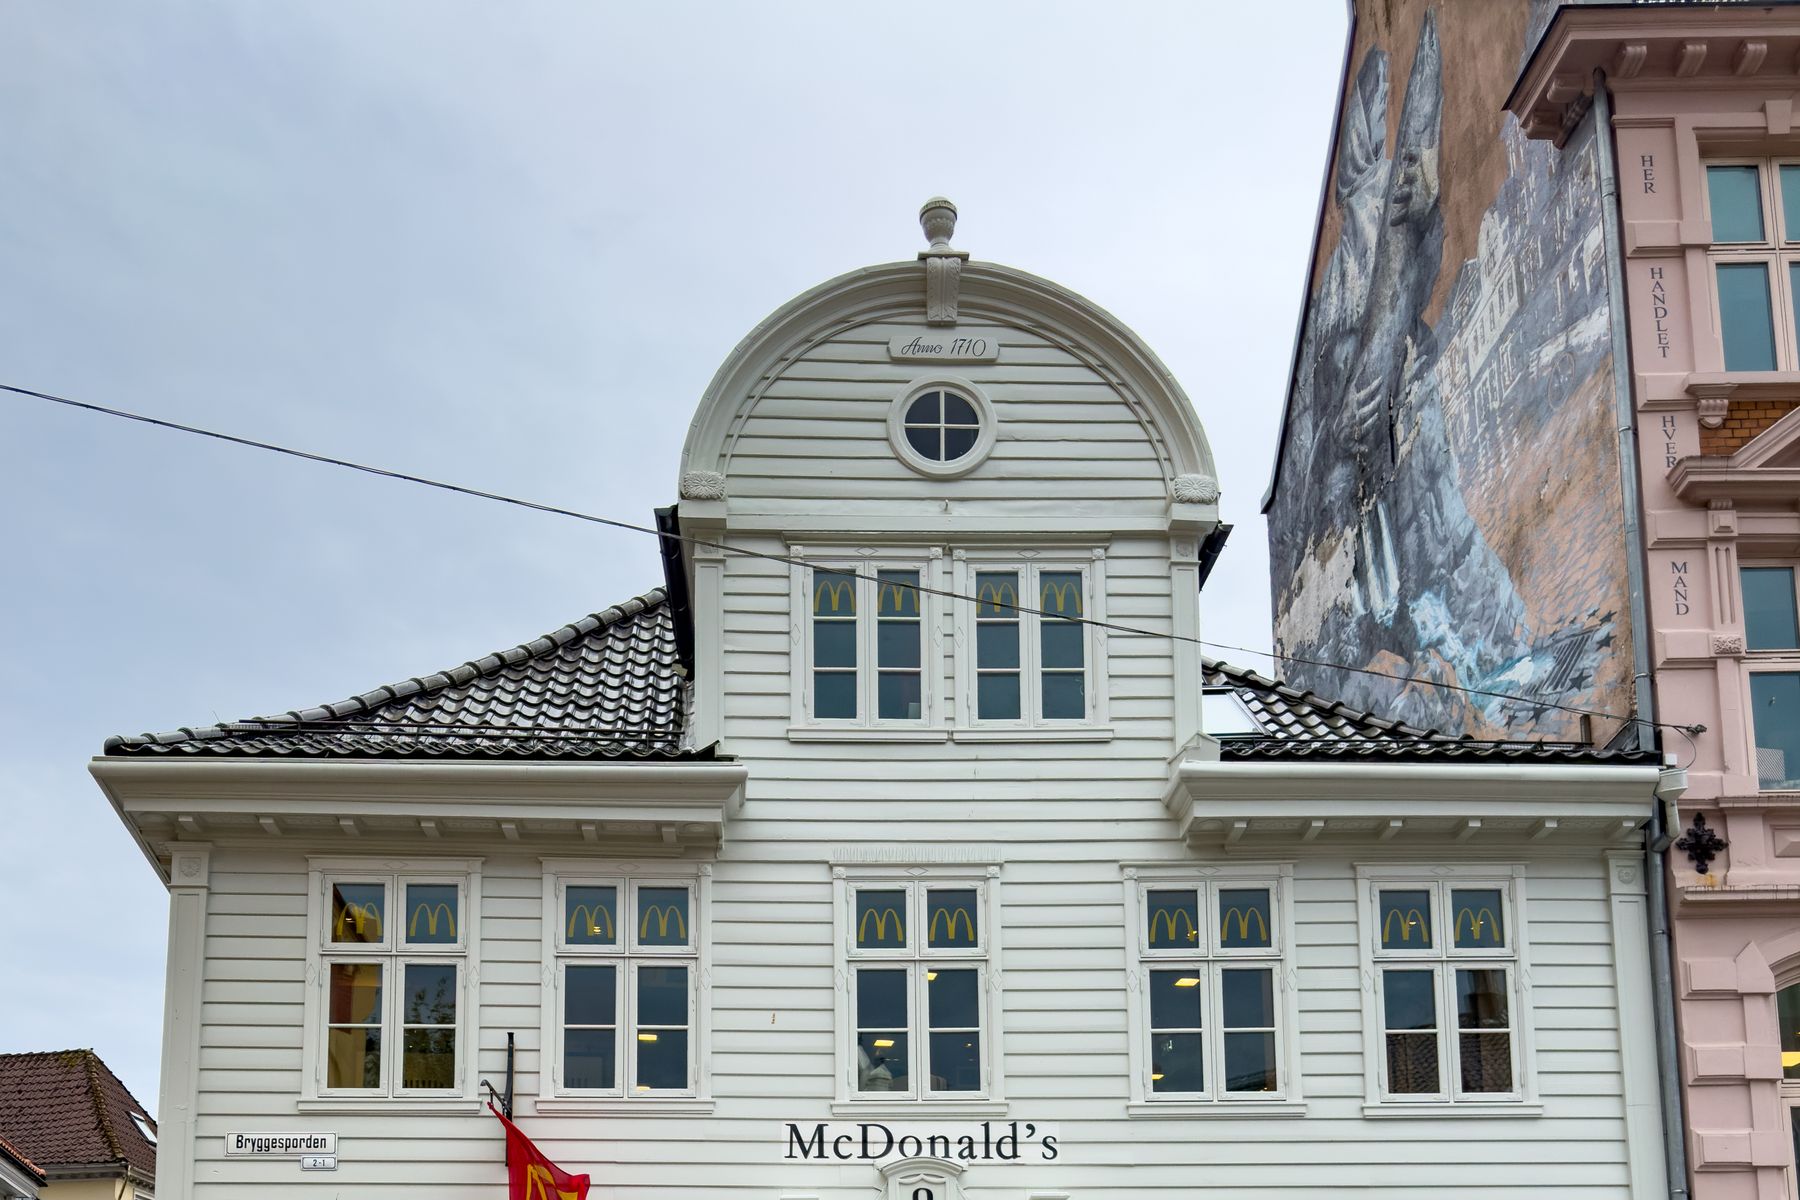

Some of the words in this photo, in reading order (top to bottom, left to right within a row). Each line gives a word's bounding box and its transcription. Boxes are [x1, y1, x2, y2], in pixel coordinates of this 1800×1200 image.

[1641, 155, 1656, 194] HER
[1650, 267, 1670, 358] HANDLET
[901, 336, 943, 356] Anno
[950, 338, 987, 357] 1710
[1662, 415, 1677, 468] HVER
[1671, 561, 1689, 616] MAND
[236, 1135, 327, 1152] Bryggesporden
[784, 1121, 1058, 1160] McDonald's
